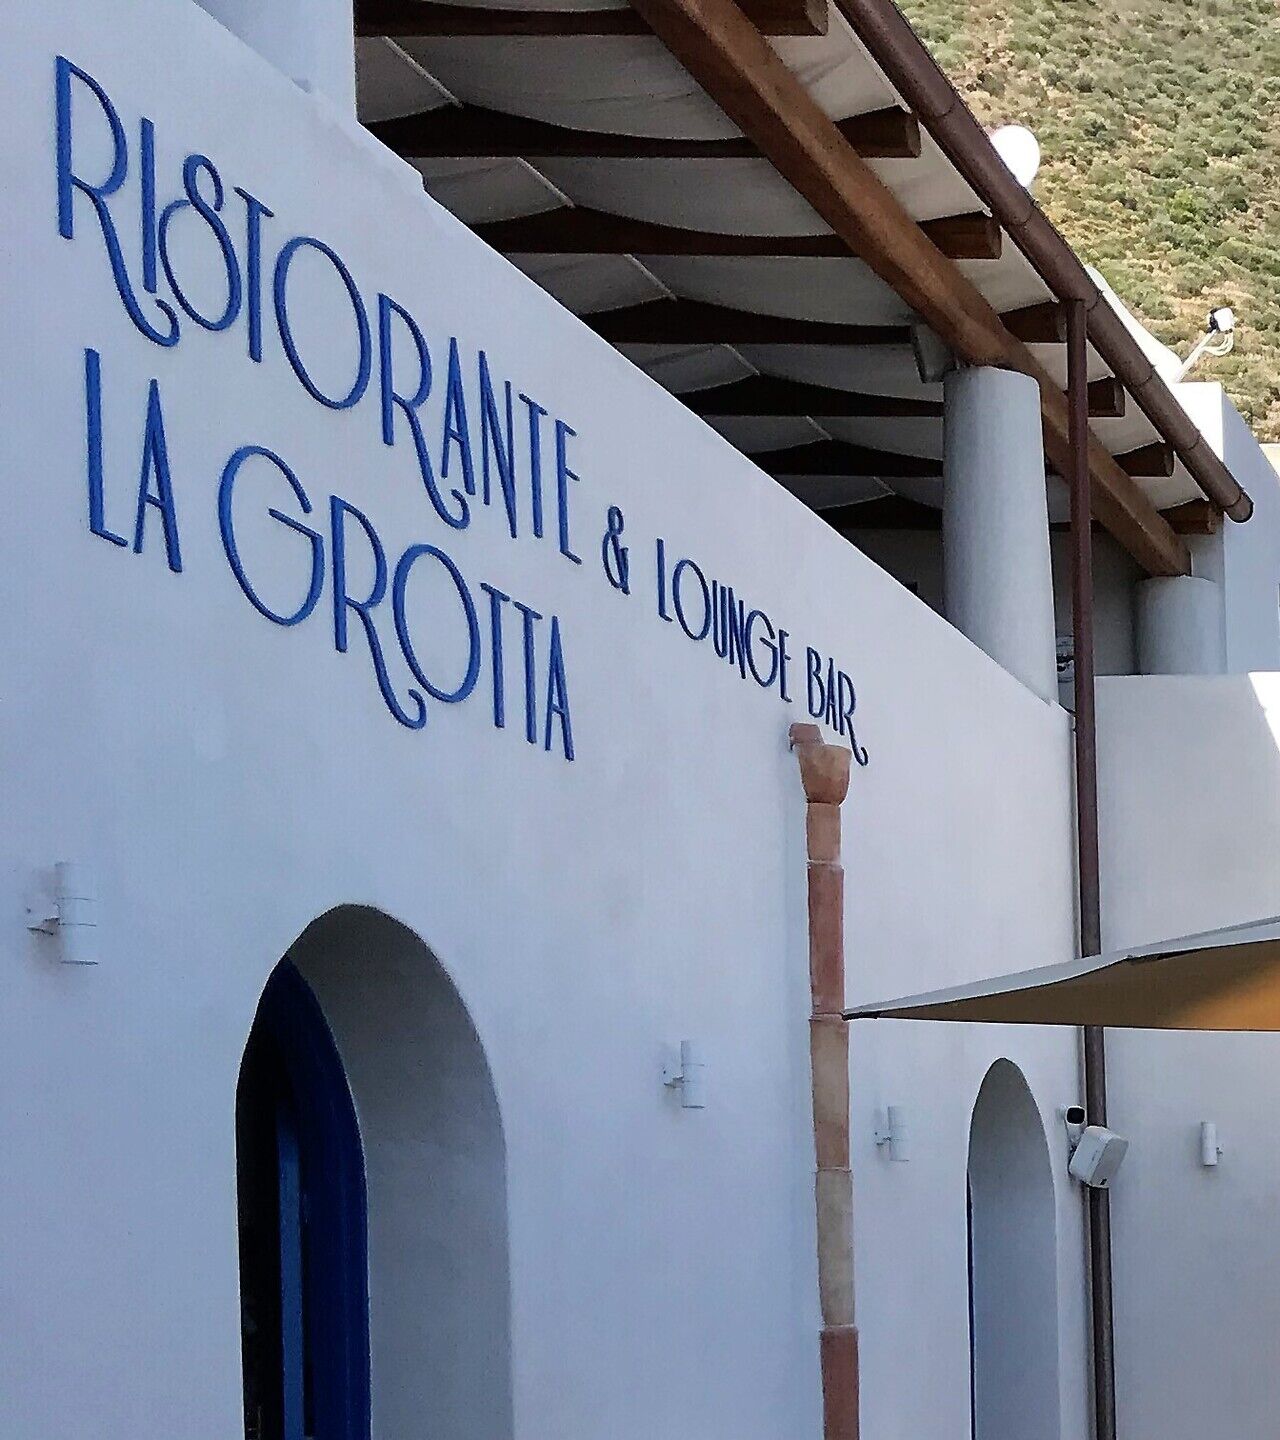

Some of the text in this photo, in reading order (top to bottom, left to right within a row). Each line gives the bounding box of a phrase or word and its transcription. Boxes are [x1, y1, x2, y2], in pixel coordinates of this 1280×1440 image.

[53, 55, 869, 767] RISTORANTE & LOUNGE BAR
[83, 346, 576, 763] LA GROTTA
